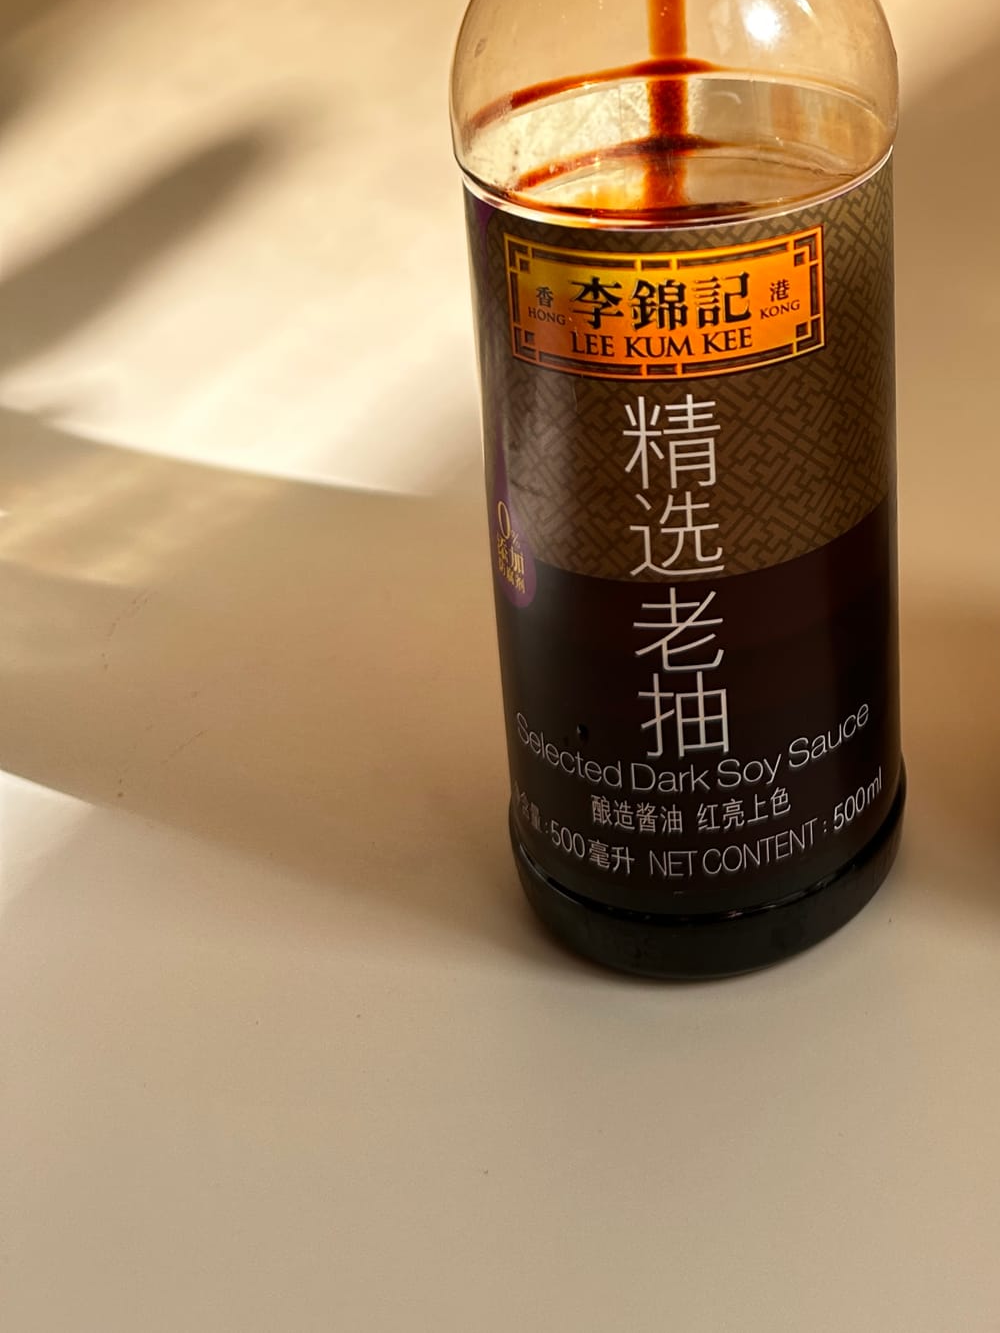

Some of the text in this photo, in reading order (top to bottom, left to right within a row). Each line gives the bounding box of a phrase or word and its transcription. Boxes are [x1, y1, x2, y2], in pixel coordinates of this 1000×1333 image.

[528, 300, 800, 326] HONG KONG
[536, 271, 790, 331] 香 李錦記 港
[571, 326, 753, 358] LEE KUM KEE
[622, 394, 729, 758] 精选老抽
[516, 703, 870, 793] Selected Dark Soy Sauce
[591, 786, 791, 834] 酿造酱油 红亮上色
[649, 850, 698, 877] NET
[833, 765, 882, 831] 500ml
